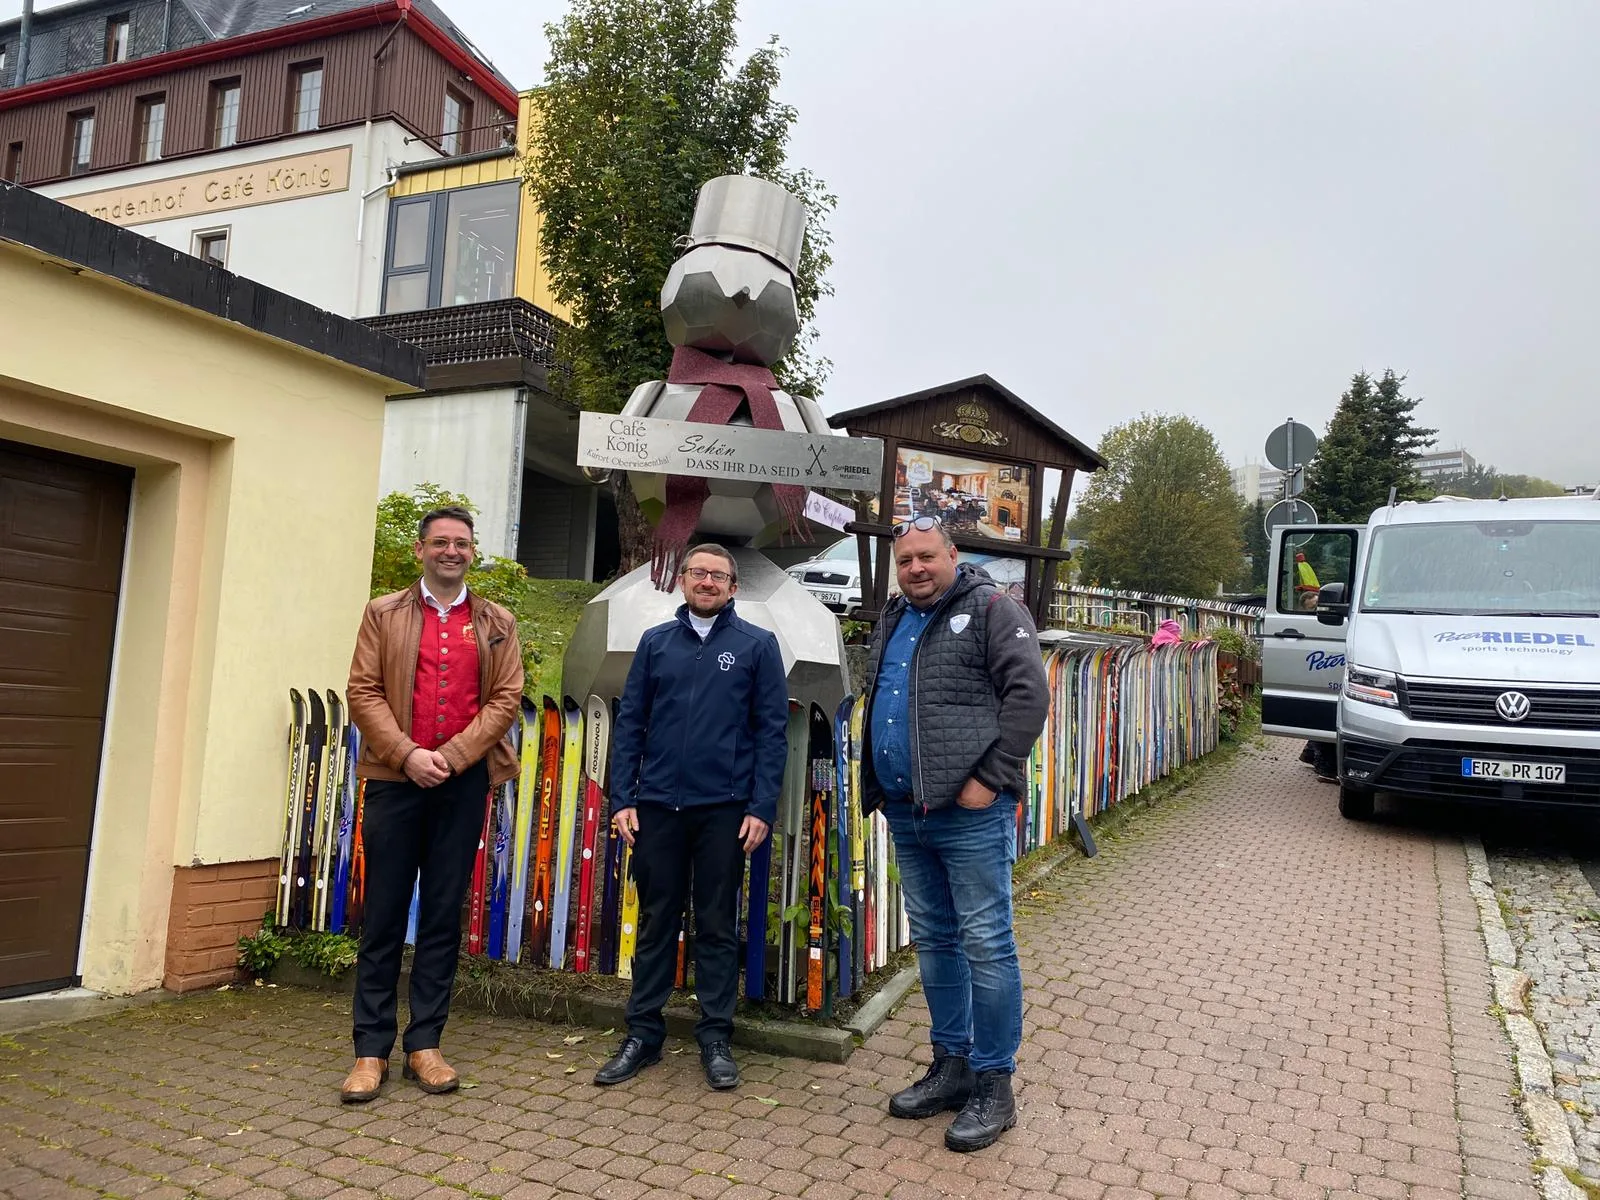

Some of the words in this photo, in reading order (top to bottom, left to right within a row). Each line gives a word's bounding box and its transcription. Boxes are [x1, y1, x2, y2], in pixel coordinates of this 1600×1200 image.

[84, 186, 187, 219] mdenhof
[205, 173, 254, 203] Café
[266, 164, 331, 193] König
[609, 419, 647, 437] Café
[586, 448, 609, 463] Kurort
[606, 435, 649, 460] König
[677, 434, 736, 457] Schön
[686, 458, 719, 471] DASS
[723, 461, 745, 473] IHR
[749, 463, 767, 475] DA
[770, 465, 800, 477] SEID
[844, 465, 871, 475] RIEDEL
[1482, 631, 1595, 647] RIEDEL
[1504, 646, 1574, 656] technology
[592, 722, 600, 774] ROSSIGNOL
[1472, 761, 1500, 776] ERZ
[1512, 763, 1531, 779] PR
[1535, 765, 1563, 781] 107
[288, 752, 298, 818] ROSSIGNOL
[306, 762, 315, 811] HEAD
[324, 754, 335, 822] ROSSIGNOL
[541, 777, 552, 839] HEAD
